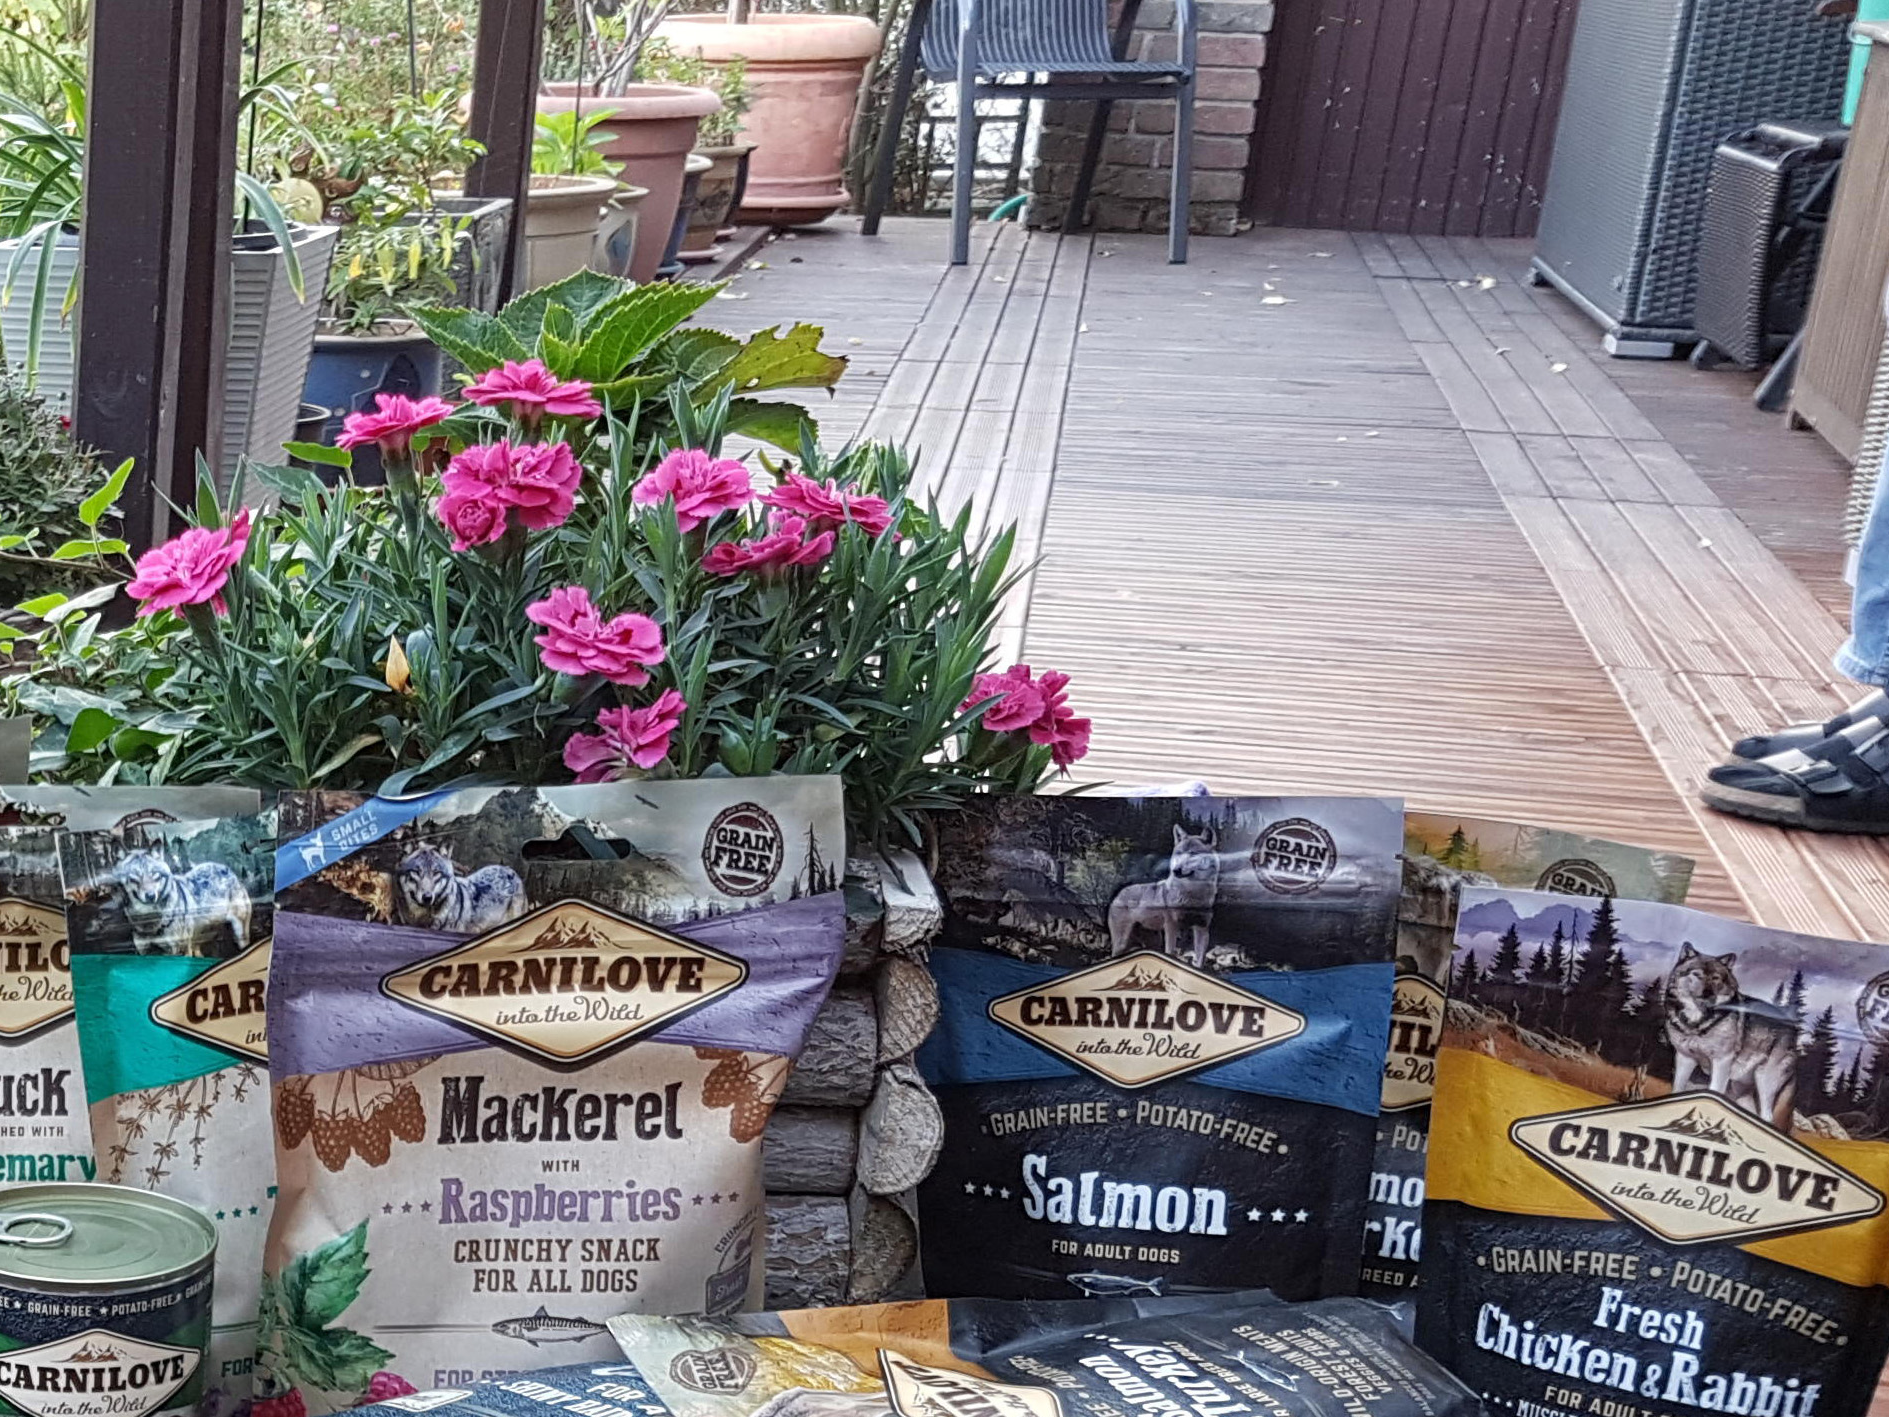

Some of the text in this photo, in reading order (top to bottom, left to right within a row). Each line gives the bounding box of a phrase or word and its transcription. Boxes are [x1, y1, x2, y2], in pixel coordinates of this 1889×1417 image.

[331, 810, 377, 841] SMALL
[714, 826, 776, 858] GRAIN
[1265, 837, 1327, 860] GRAIN
[709, 849, 773, 876] FREE
[1263, 852, 1323, 880] FREE
[418, 956, 706, 998] CARNILOVE
[496, 996, 645, 1027] into the Wild
[1020, 995, 1265, 1038] CARNILOVE
[1076, 1033, 1201, 1060] into the Wild
[437, 1075, 683, 1145] Mackerel
[31, 1125, 65, 1137] WITH
[991, 1101, 1277, 1154] GRAIN-FREE POTATO-FREE
[541, 1159, 581, 1173] WITH
[1547, 1122, 1842, 1211] CARNILOVE
[439, 1177, 682, 1229] Raspberries
[1021, 1154, 1228, 1236] Salmon
[452, 1237, 661, 1264] CRUNCHY SNACK
[1052, 1239, 1180, 1264] FOR ADULT DOGS
[472, 1268, 638, 1294] FOR ALL DOGS
[1491, 1246, 1838, 1345] GRAIN-FREE POTATO-FREE
[28, 1293, 175, 1317] GRAIN-FREE POTATO-FREE
[1593, 1286, 1705, 1350] Fresh
[1474, 1302, 1637, 1391] Chicken
[1640, 1362, 1661, 1399] &
[221, 1359, 253, 1377] FOR
[41, 1393, 148, 1417] into the Wild
[1544, 1386, 1581, 1409] FOR
